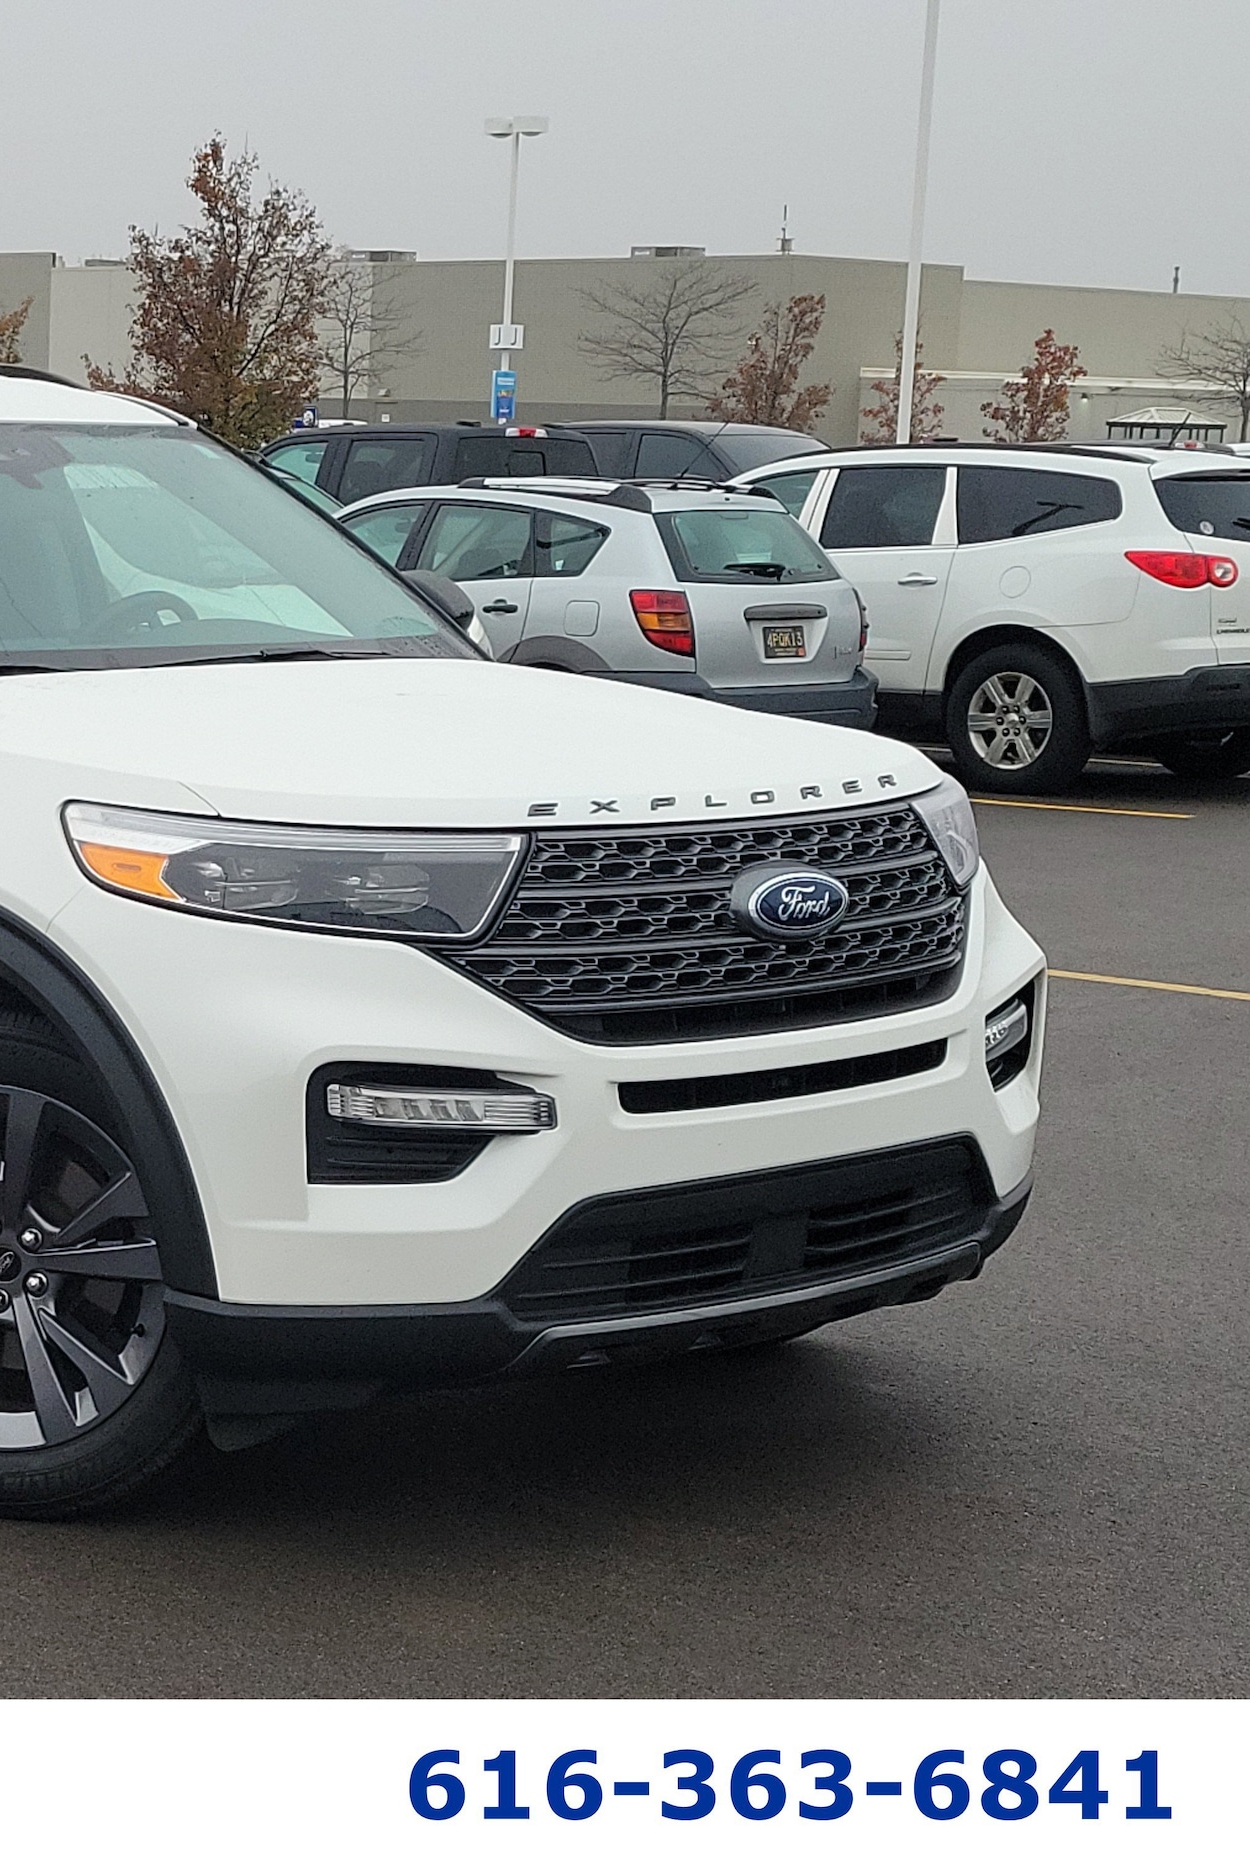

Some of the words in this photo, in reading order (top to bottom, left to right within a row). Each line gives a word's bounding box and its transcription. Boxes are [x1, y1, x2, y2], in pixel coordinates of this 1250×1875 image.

[494, 327, 502, 346] J
[510, 327, 518, 346] J
[527, 774, 898, 817] EXPLORER
[778, 885, 830, 921] Ford
